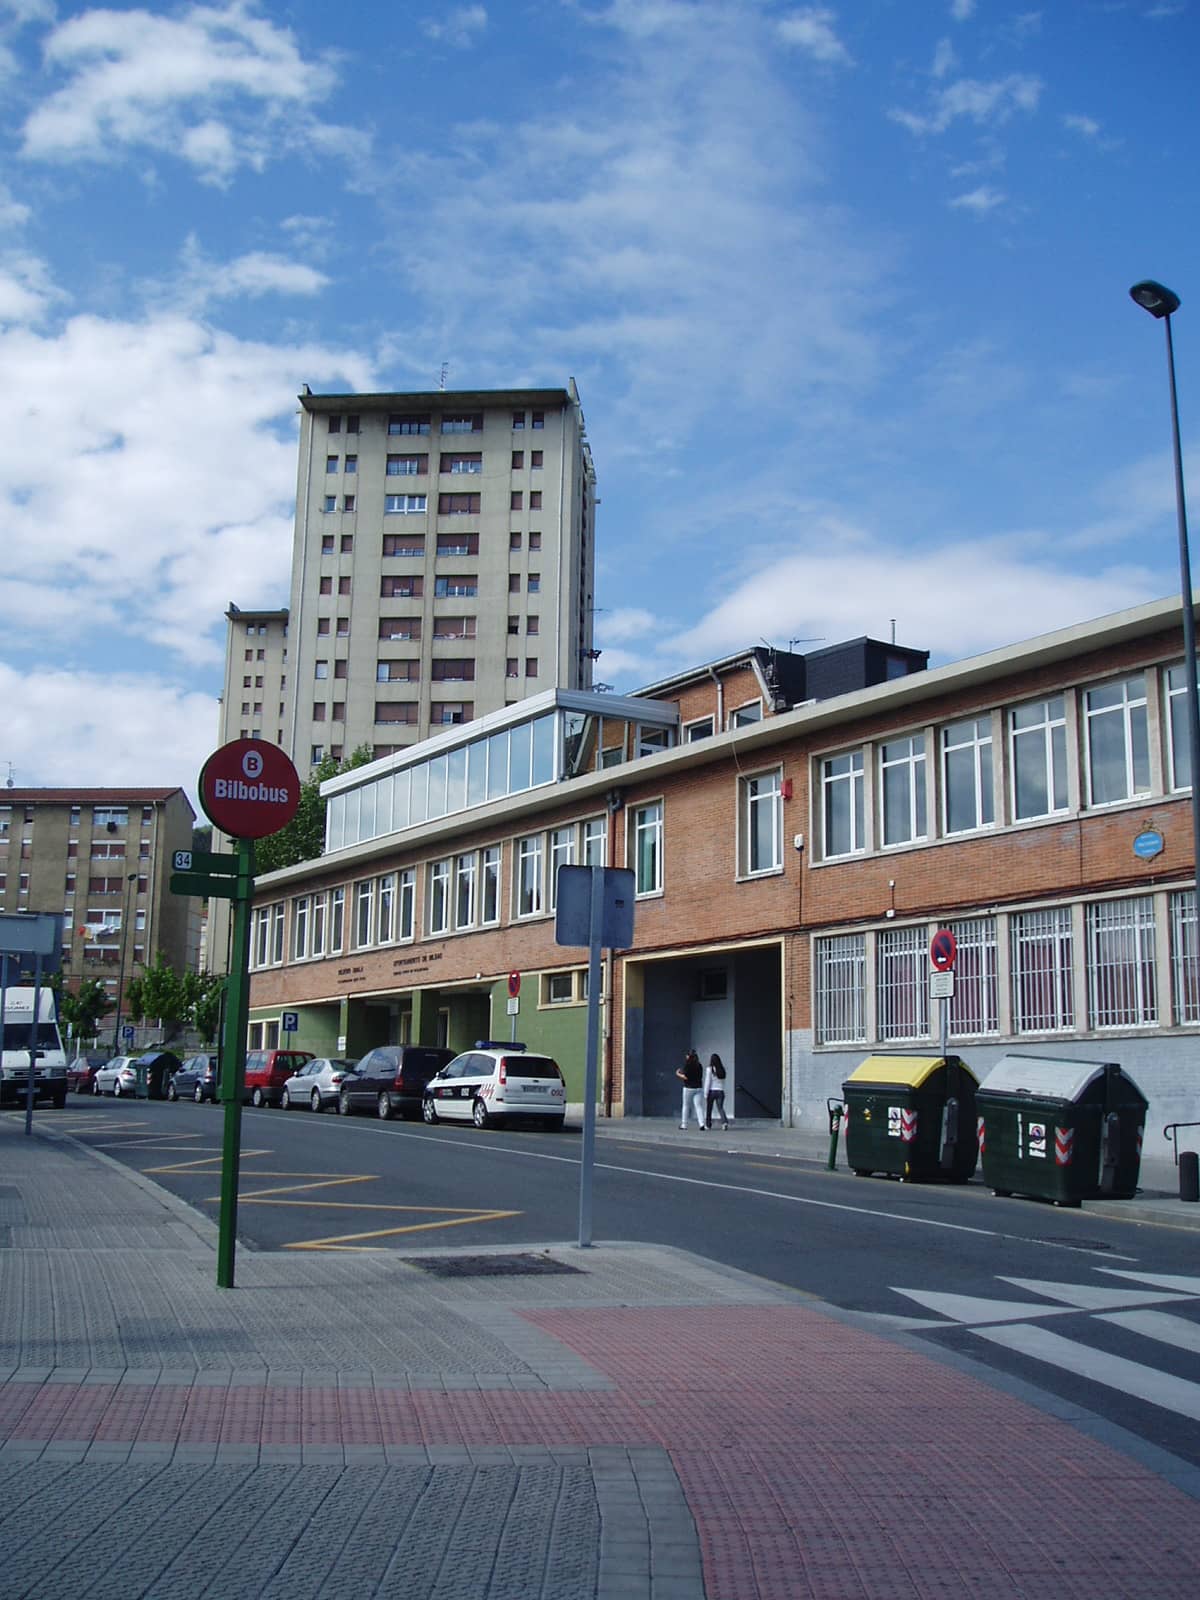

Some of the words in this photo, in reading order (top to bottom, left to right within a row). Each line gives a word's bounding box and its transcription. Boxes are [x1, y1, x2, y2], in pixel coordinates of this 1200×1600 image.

[247, 757, 258, 771] B
[215, 778, 289, 803] Bilbobus
[176, 852, 190, 867] 34
[284, 1014, 296, 1029] P
[124, 1028, 132, 1038] P
